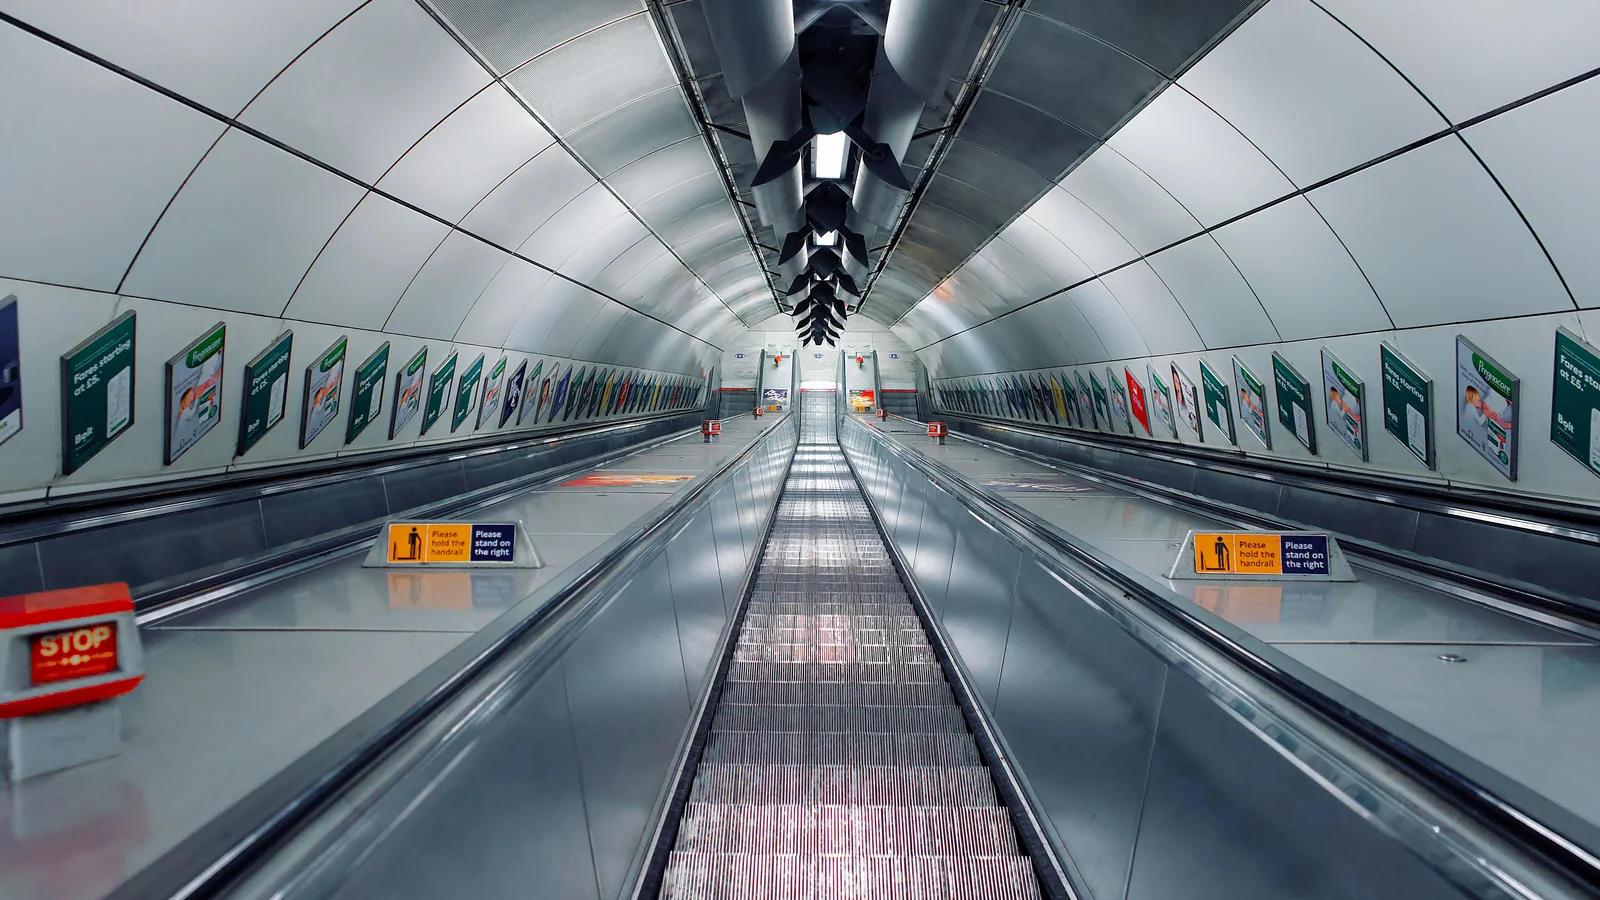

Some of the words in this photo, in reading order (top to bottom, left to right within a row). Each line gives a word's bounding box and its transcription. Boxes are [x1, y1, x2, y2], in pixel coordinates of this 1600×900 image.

[74, 363, 98, 385] Fares
[99, 339, 131, 368] starting
[1560, 354, 1583, 378] Fares
[1478, 360, 1511, 394] Pregnacare
[1560, 369, 1570, 381] at
[74, 384, 86, 396] at
[1557, 412, 1575, 434] Bolt
[75, 427, 93, 445] Bolt
[1240, 541, 1267, 549] Please
[1285, 541, 1313, 550] Please
[490, 548, 510, 557] right
[1285, 551, 1310, 559] stand
[1303, 560, 1324, 570] right
[41, 626, 112, 657] STOP
